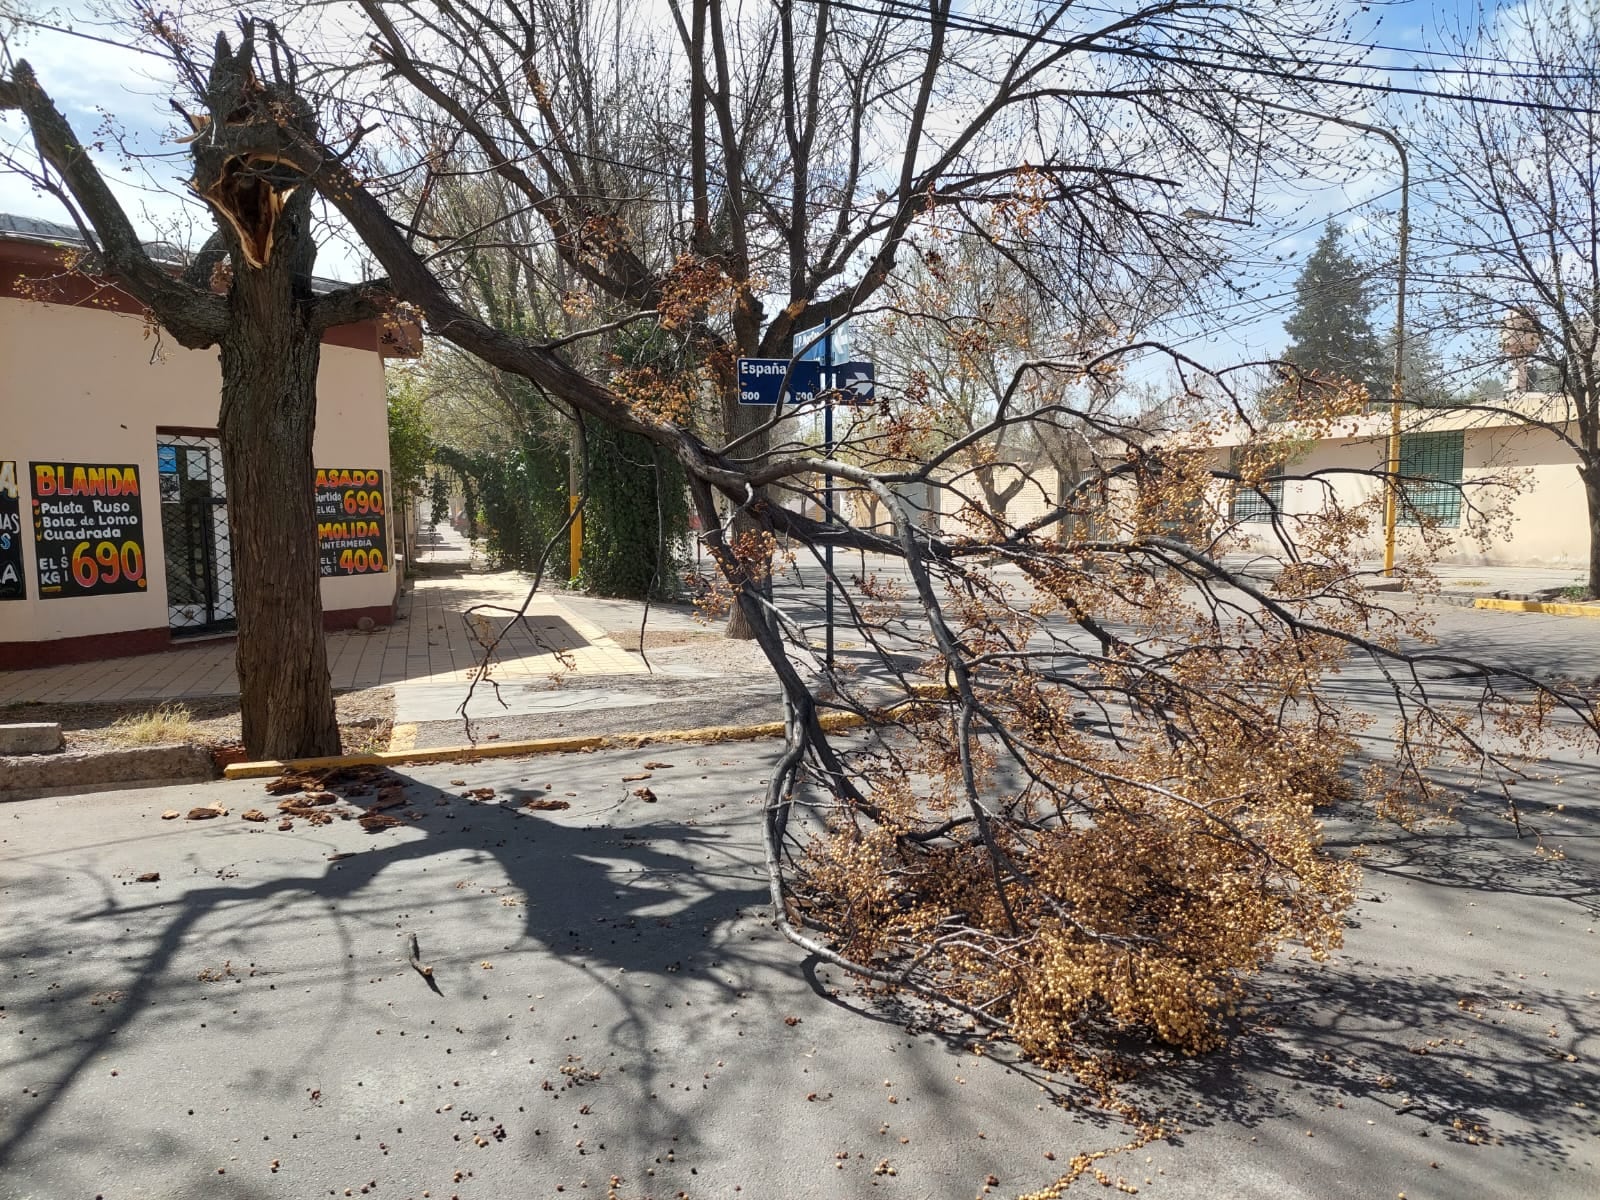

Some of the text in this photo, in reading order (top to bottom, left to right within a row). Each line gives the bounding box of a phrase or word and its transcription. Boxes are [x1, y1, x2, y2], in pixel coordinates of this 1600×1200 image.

[741, 362, 787, 378] España
[35, 465, 139, 497] BLANDA
[315, 469, 379, 488] ASADO
[41, 500, 130, 515] Paleta Ruso
[42, 515, 138, 528] Bola de Lomo
[43, 527, 122, 541] Cuadrada
[317, 522, 380, 540] MOLIDA
[321, 539, 373, 550] INTERMEDIA
[39, 558, 58, 570] EL
[41, 571, 61, 585] KG
